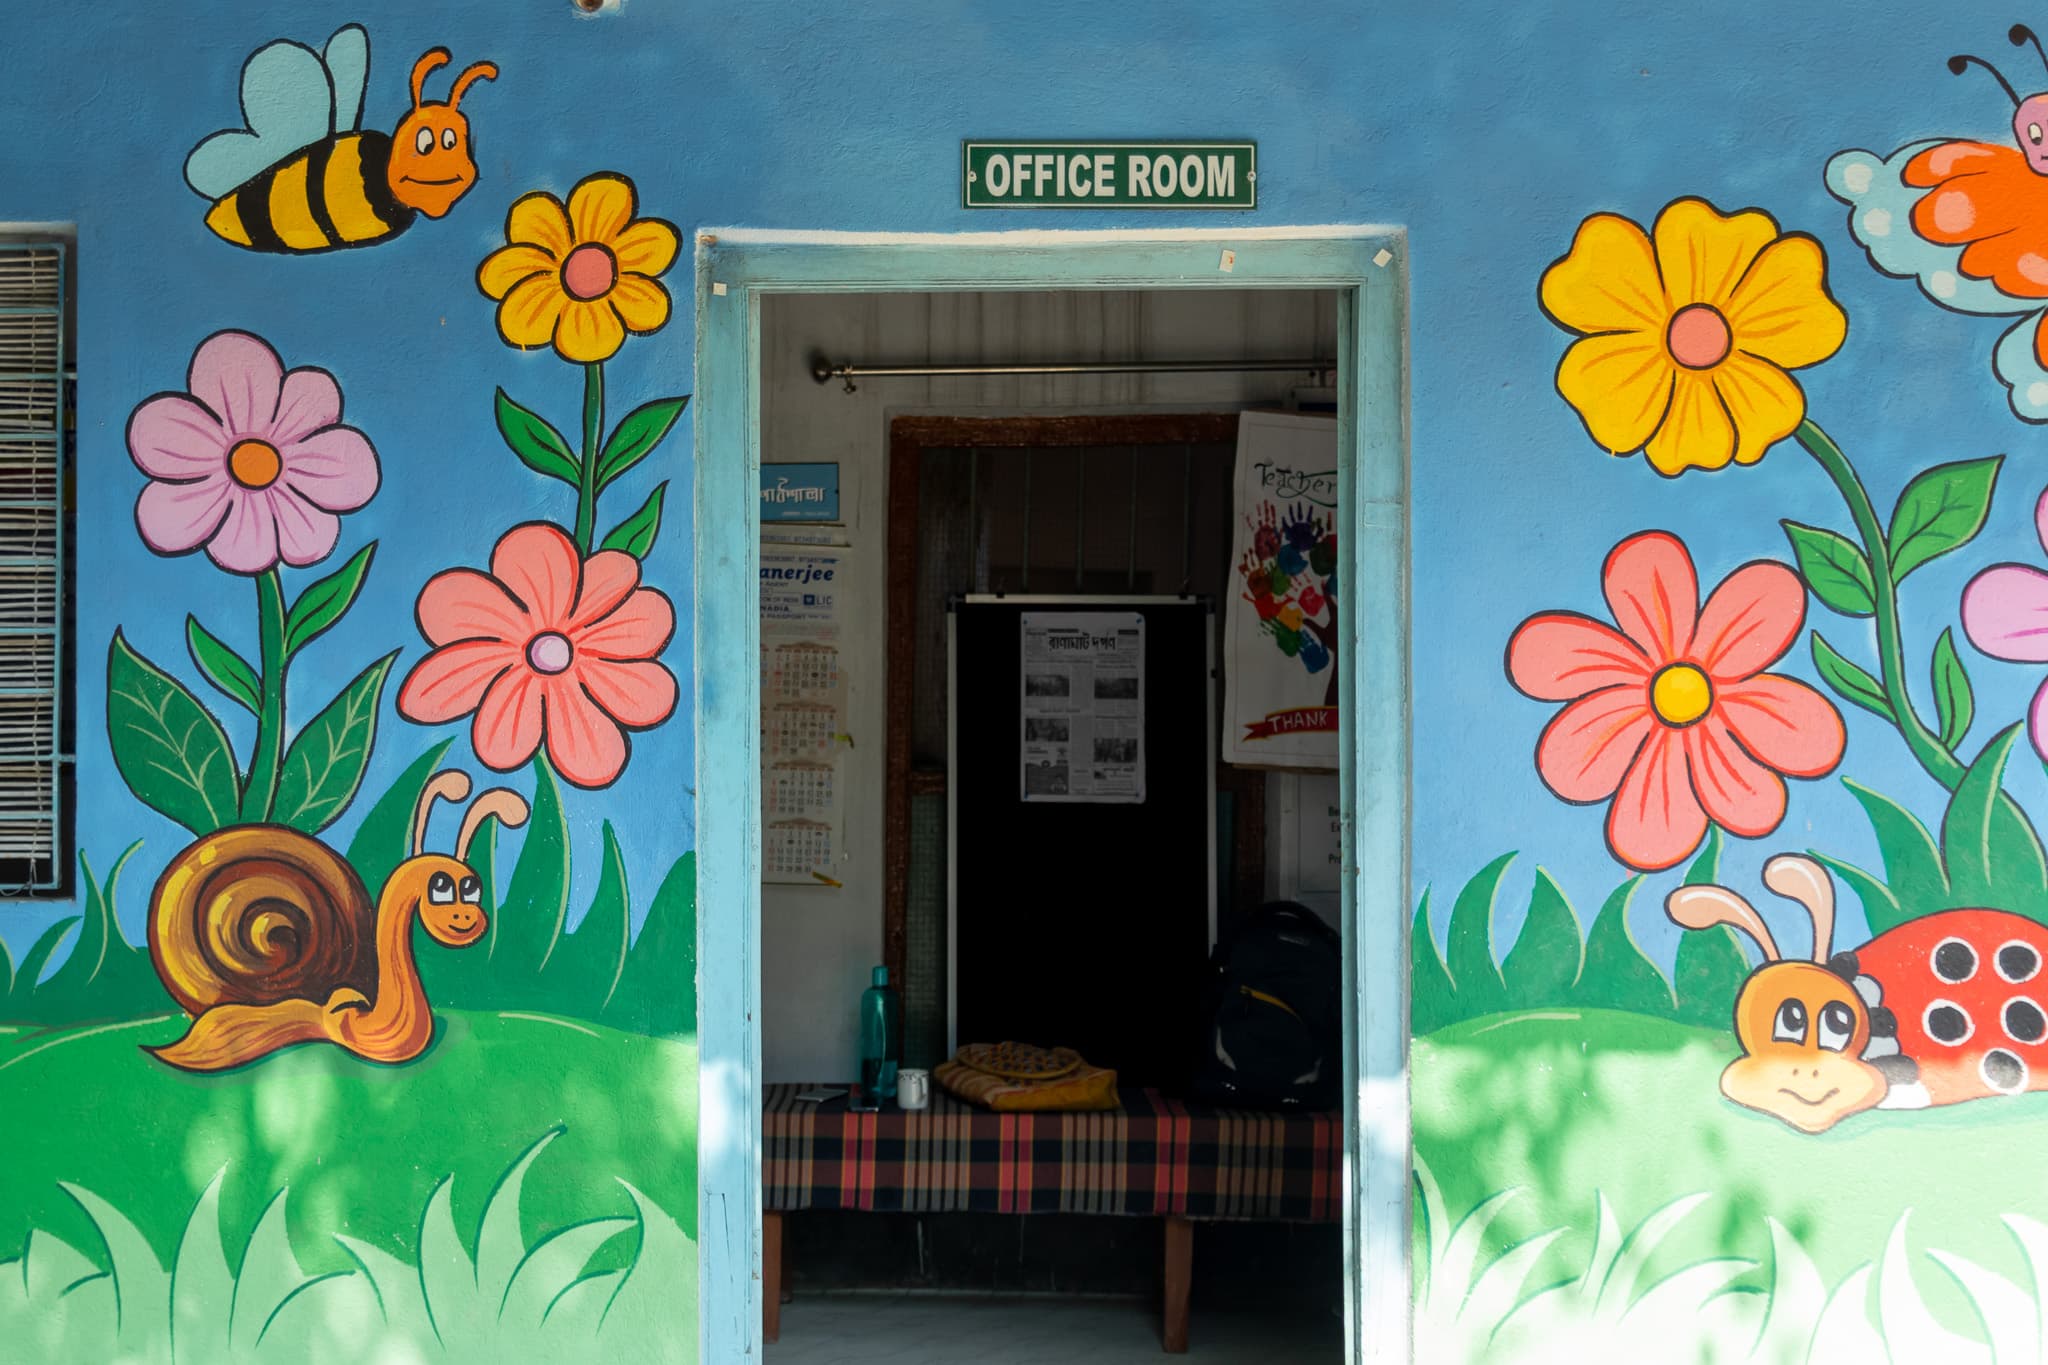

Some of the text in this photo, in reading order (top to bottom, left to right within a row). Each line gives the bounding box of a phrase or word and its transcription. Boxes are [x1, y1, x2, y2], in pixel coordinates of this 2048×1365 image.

[985, 154, 1236, 198] OFFICE ROOM
[816, 596, 832, 605] LIC
[1268, 710, 1328, 733] THANK
